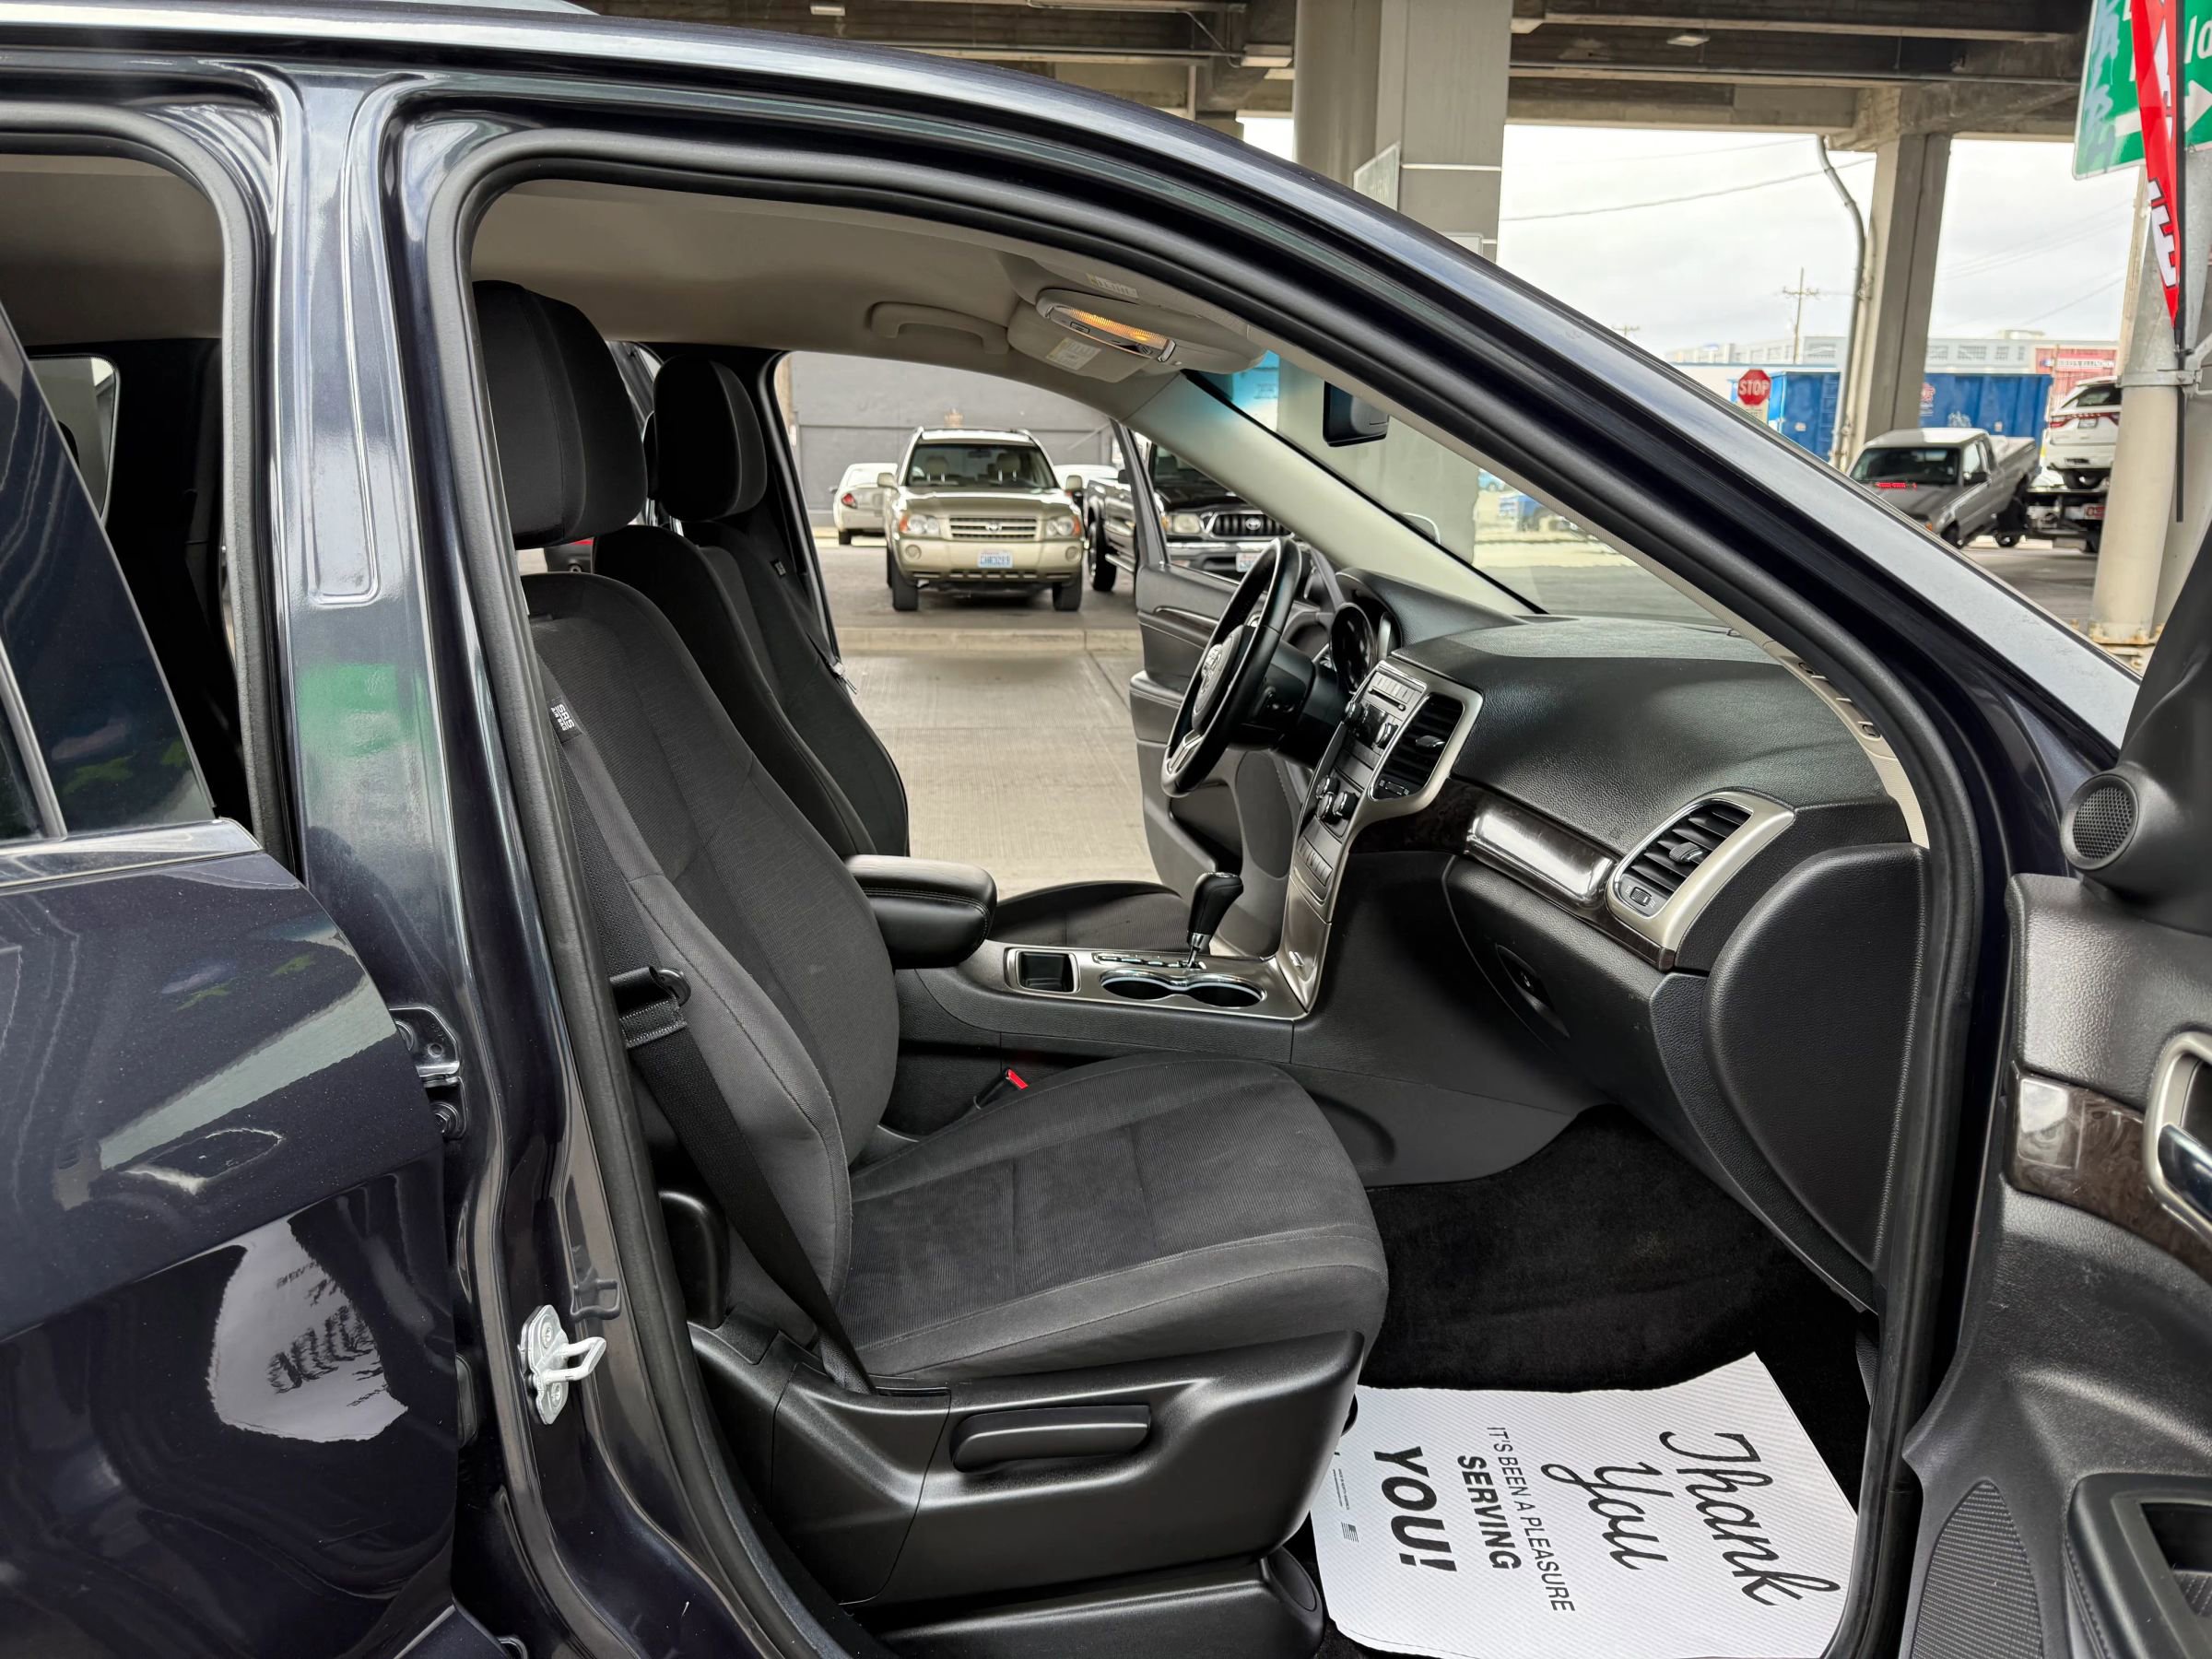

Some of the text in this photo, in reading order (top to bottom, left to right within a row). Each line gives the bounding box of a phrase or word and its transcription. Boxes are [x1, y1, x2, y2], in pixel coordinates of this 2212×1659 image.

[1739, 379, 1770, 396] STOP
[557, 718, 568, 731] BAG
[558, 703, 574, 729] SRS
[1373, 1446, 1457, 1572] YOU!
[1457, 1455, 1522, 1570] SERVING
[1486, 1426, 1575, 1611] IT'S BEEN A PLEASURE
[1540, 1461, 1675, 1571] You
[1658, 1430, 1841, 1606] Thank
